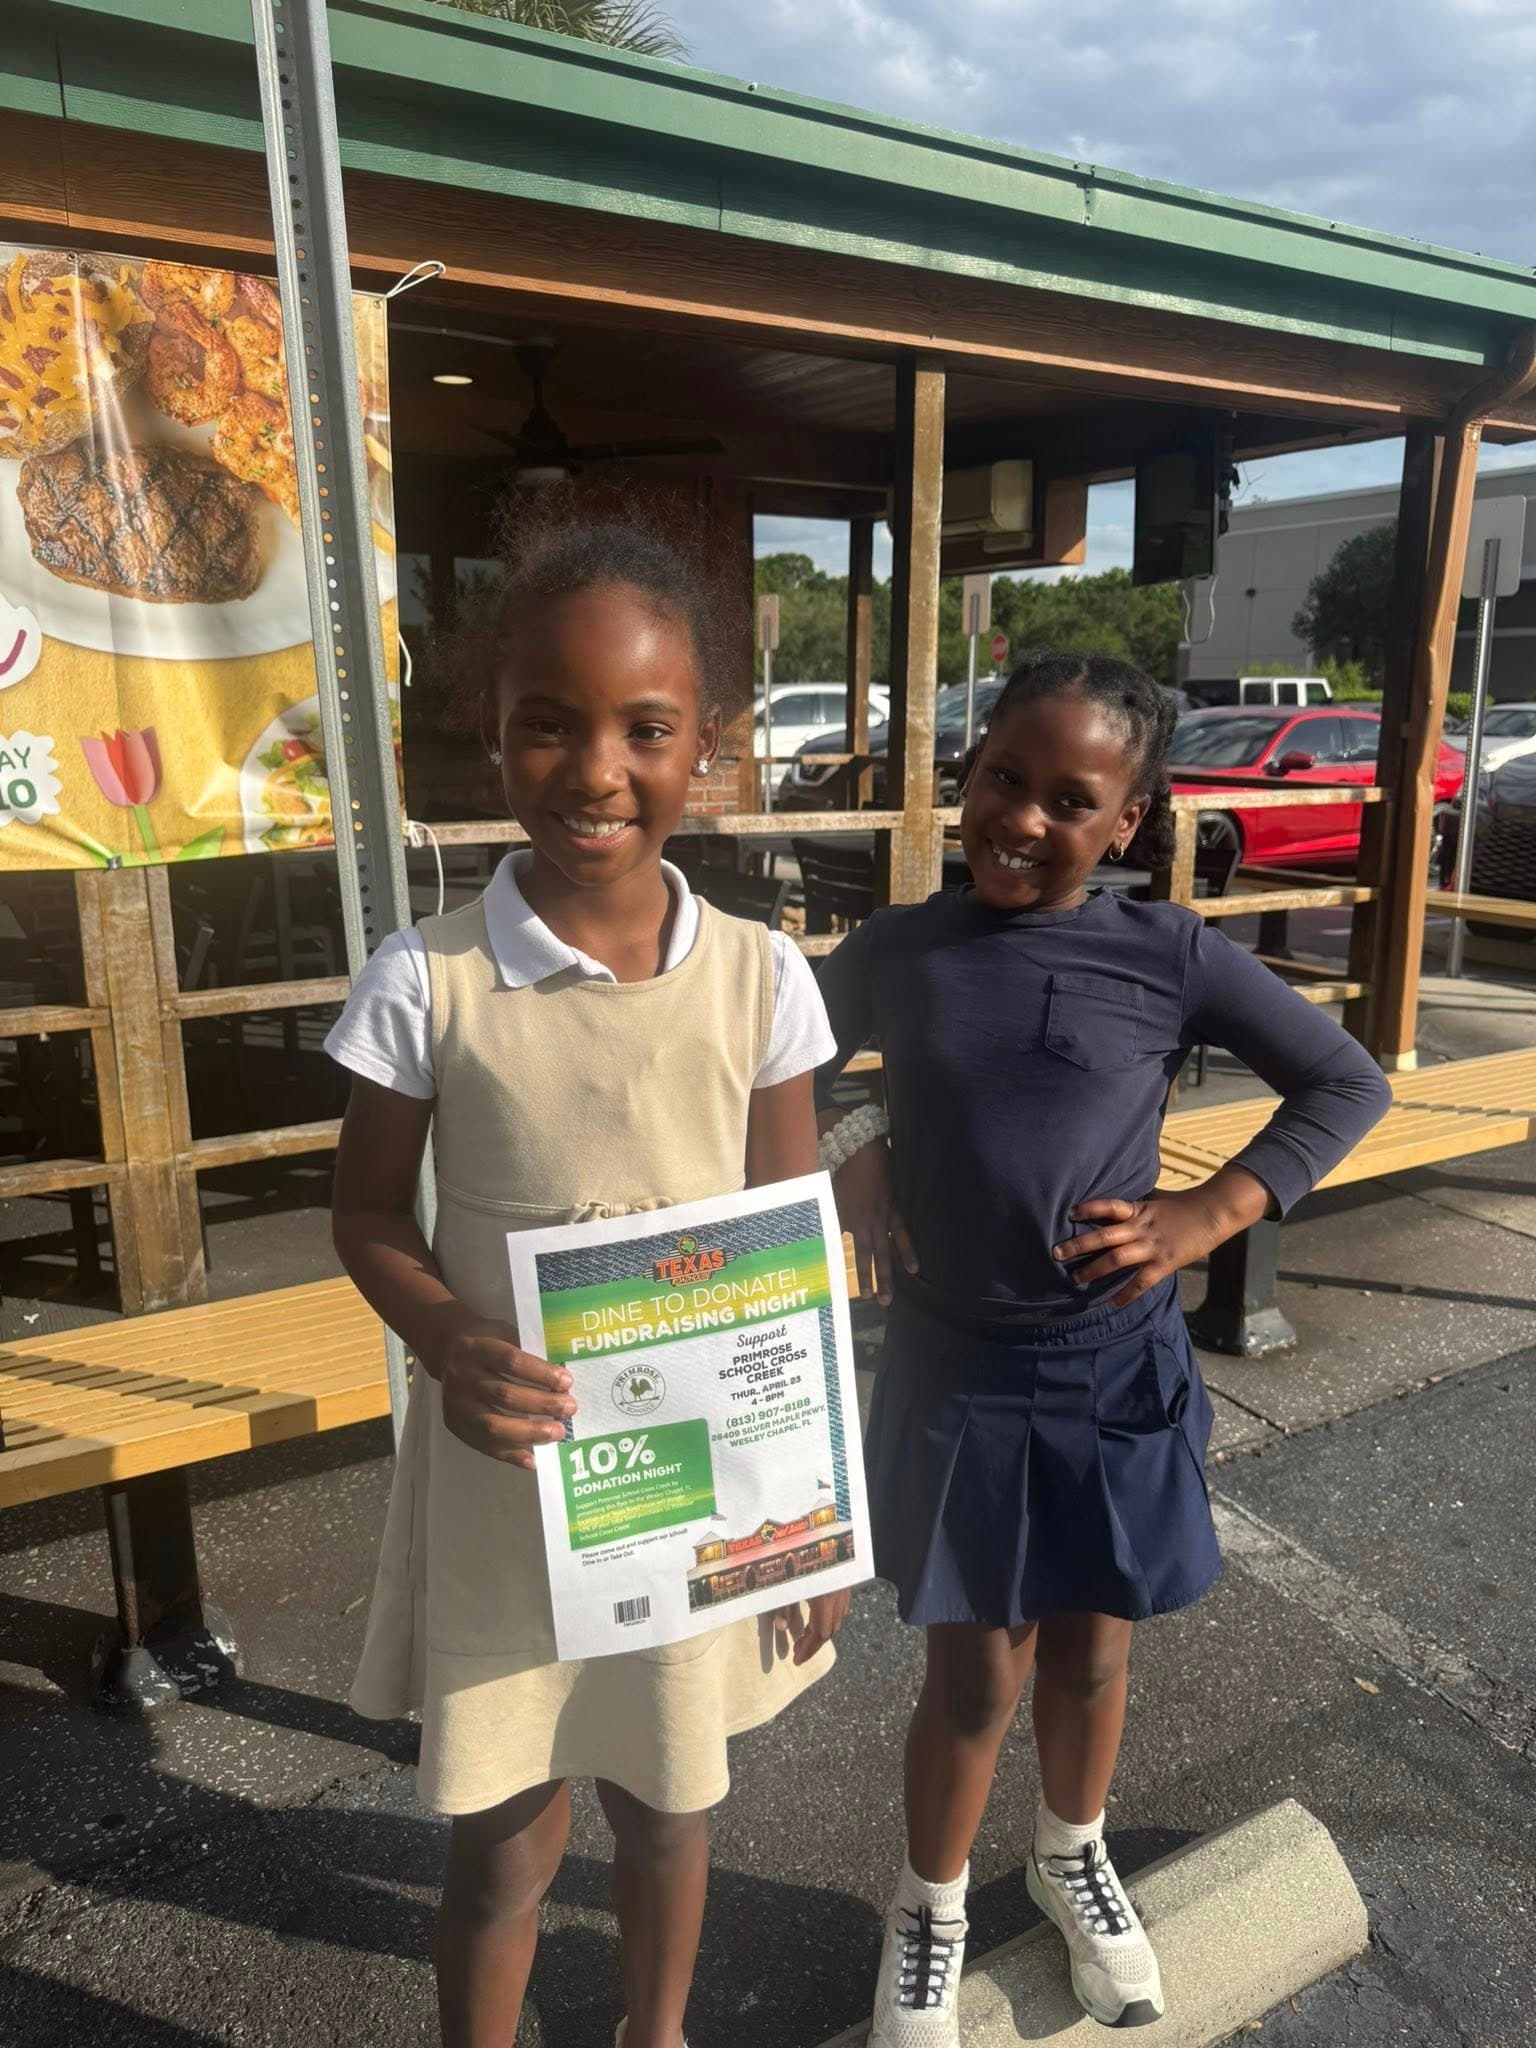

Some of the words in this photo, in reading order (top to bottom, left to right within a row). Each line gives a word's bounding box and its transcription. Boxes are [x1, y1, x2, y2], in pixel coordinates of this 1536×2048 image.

[656, 1250, 724, 1279] TEXAS
[582, 1301, 644, 1331] DINE
[650, 1293, 685, 1316] TO
[693, 1267, 797, 1308] DONATE!
[571, 1306, 735, 1354] FUNDRAISING
[744, 1288, 809, 1319] NIGHT
[737, 1324, 788, 1349] Support
[718, 1360, 768, 1380] SCHOOL
[770, 1349, 808, 1367] CROSS
[733, 1342, 792, 1366] PRIMROSE
[746, 1366, 784, 1384] CREEK
[762, 1380, 789, 1393] APRIL
[726, 1411, 756, 1430] (813)
[730, 1432, 765, 1448] WESLEY
[802, 1419, 812, 1427] FL
[742, 1422, 771, 1436] SILVER
[772, 1412, 801, 1427] MAPLE
[569, 1434, 656, 1482] 10%
[573, 1471, 641, 1498] DONATION
[643, 1462, 683, 1480] NIGHT
